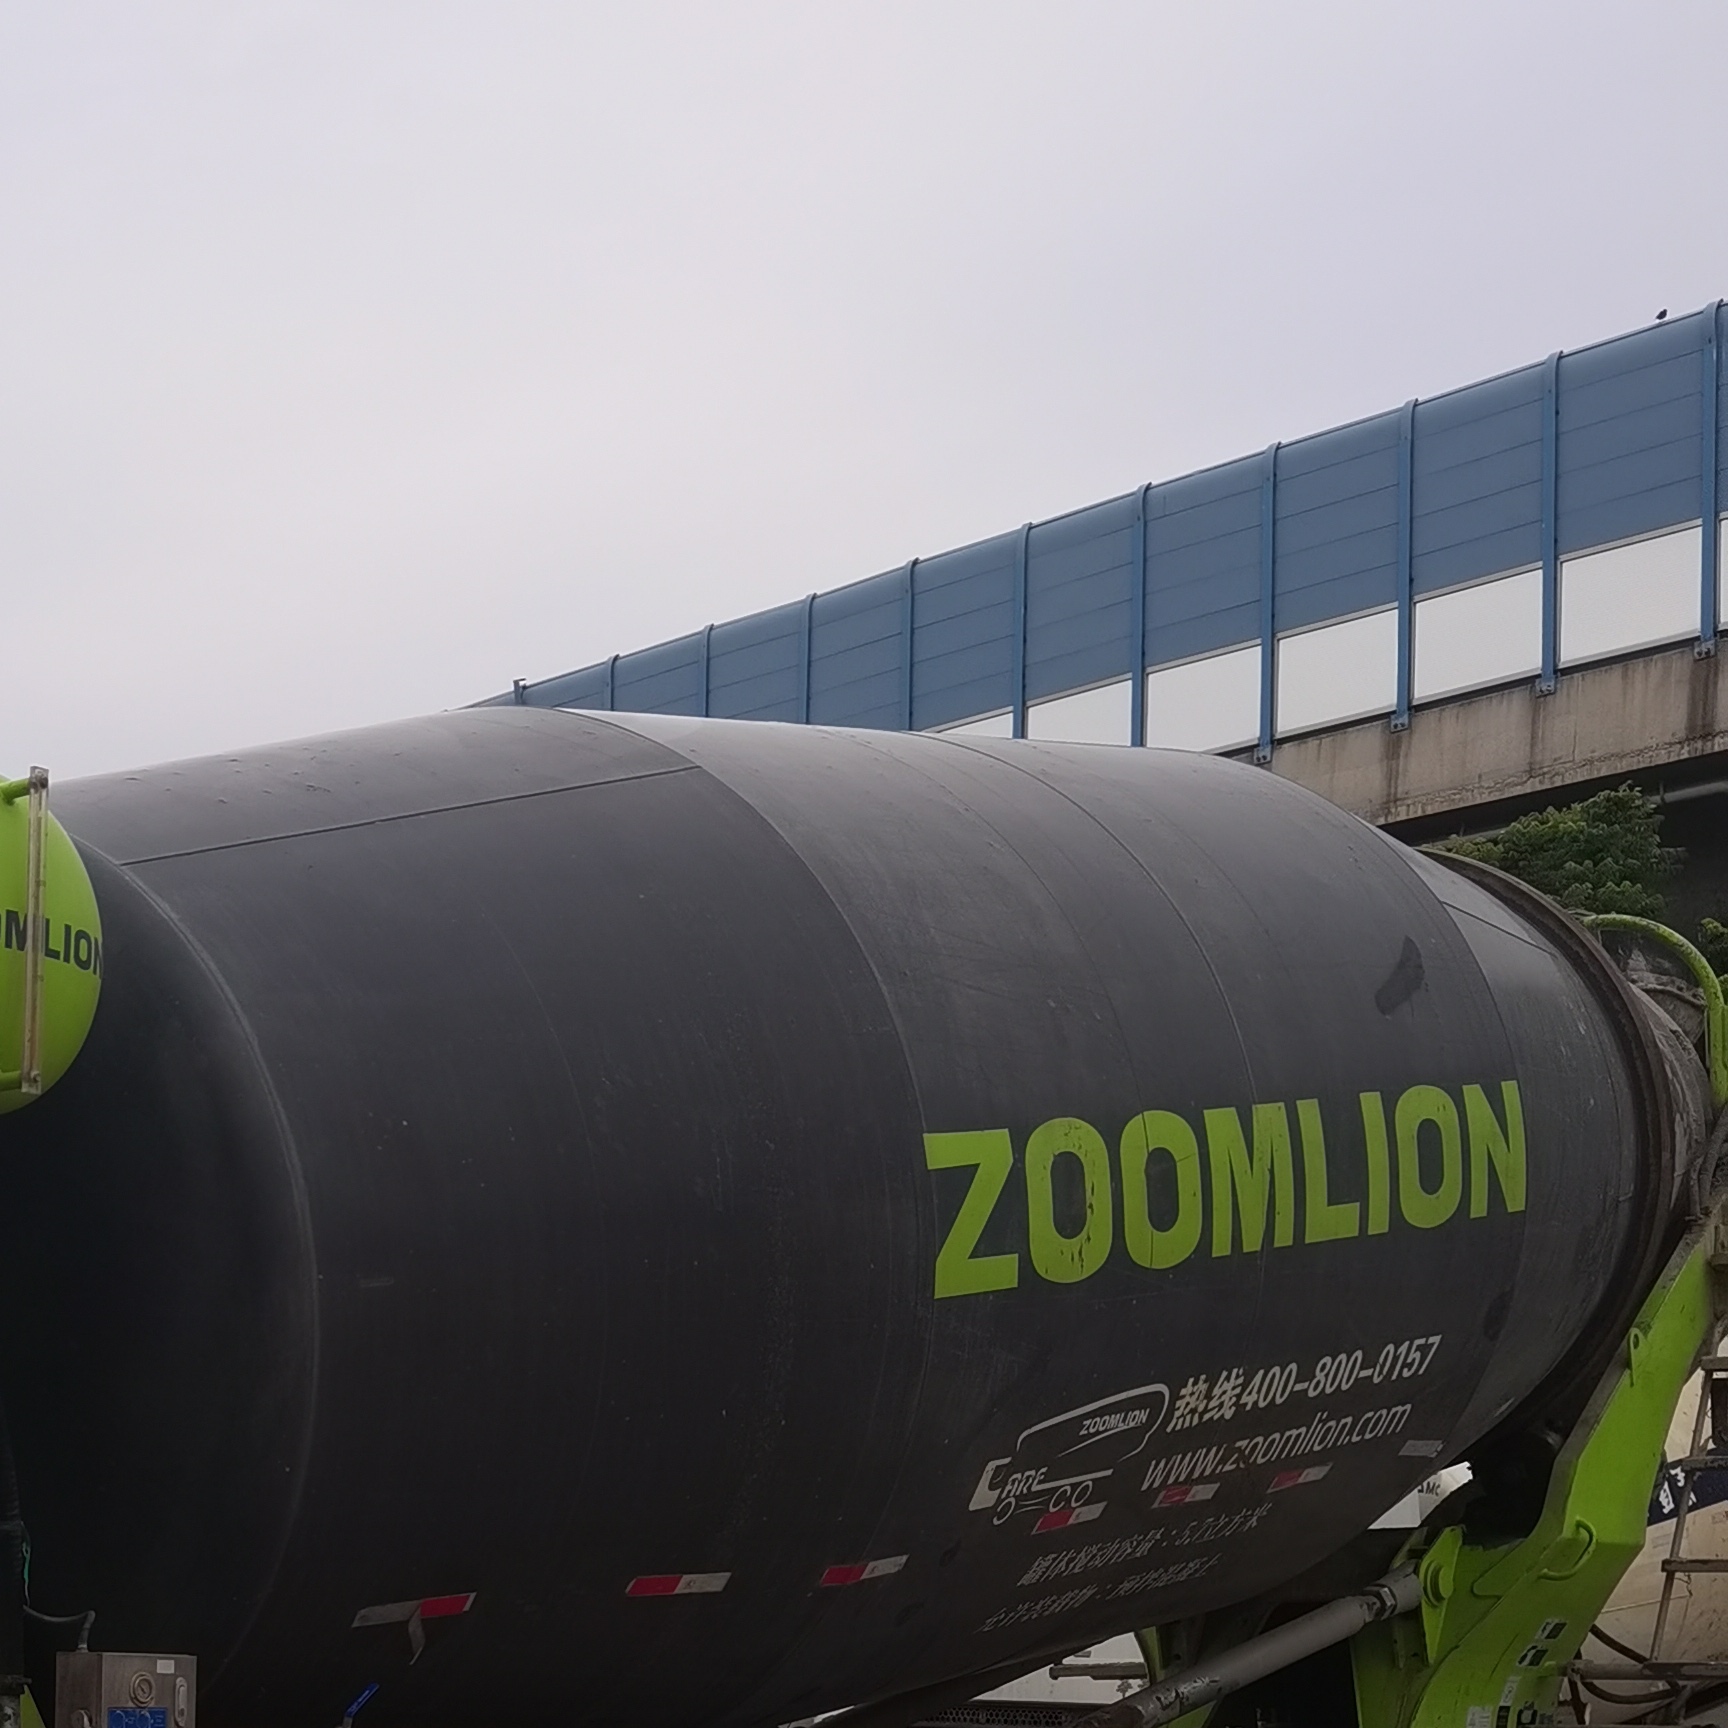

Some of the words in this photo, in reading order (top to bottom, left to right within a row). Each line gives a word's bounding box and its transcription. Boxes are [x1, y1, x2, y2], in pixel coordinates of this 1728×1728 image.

[923, 1080, 1527, 1299] ZOOMLION
[1079, 1408, 1150, 1436] ZOOMLION
[1166, 1335, 1442, 1433] 热线400-800-0157
